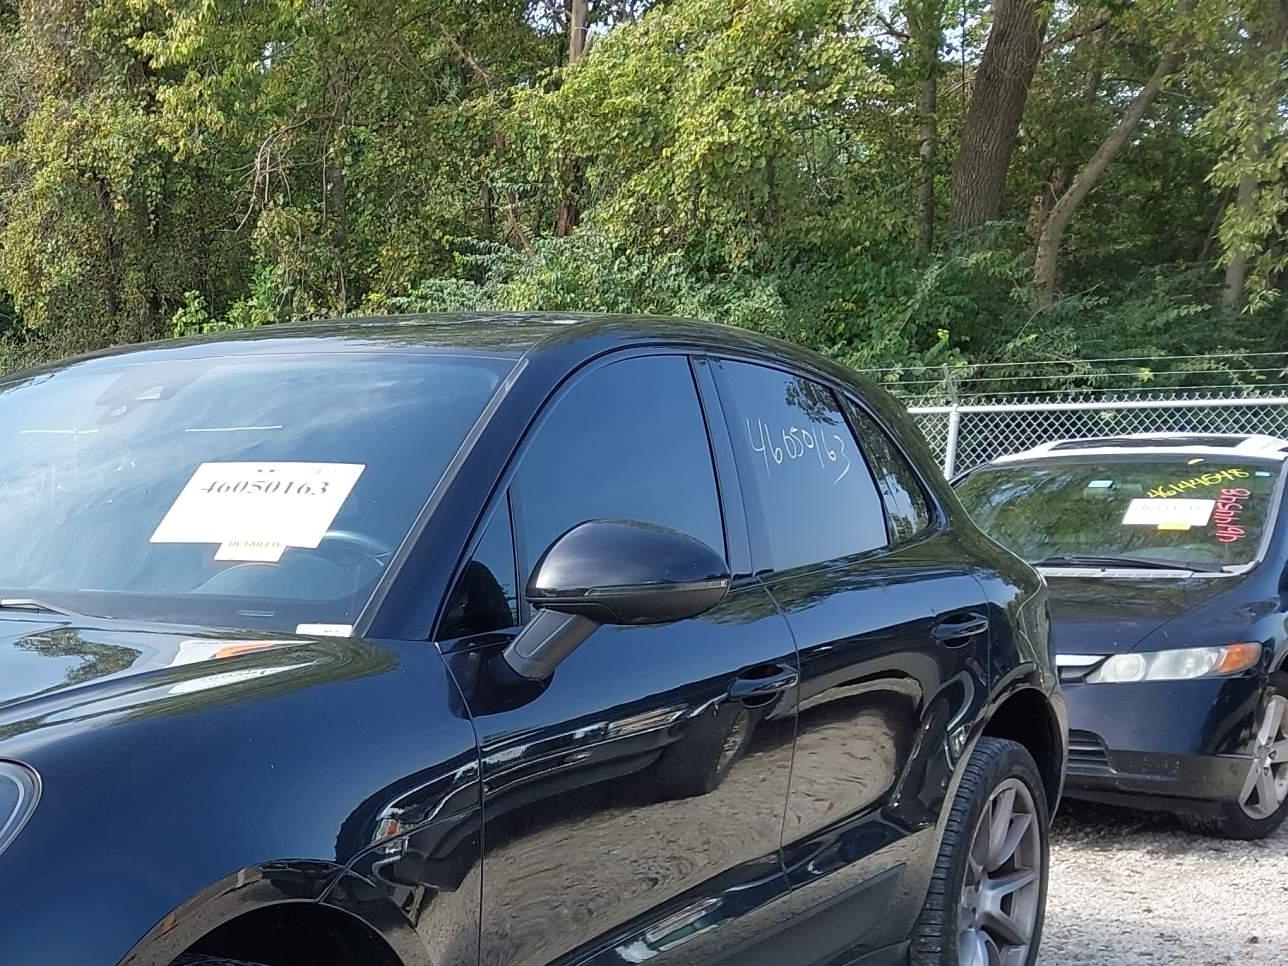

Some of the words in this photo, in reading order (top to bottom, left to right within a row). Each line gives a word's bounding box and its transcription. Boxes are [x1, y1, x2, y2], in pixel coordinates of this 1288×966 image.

[746, 417, 851, 487] 46050163
[200, 480, 331, 496] 46050163
[1147, 468, 1250, 498] 46144548
[1213, 488, 1252, 543] 46144548
